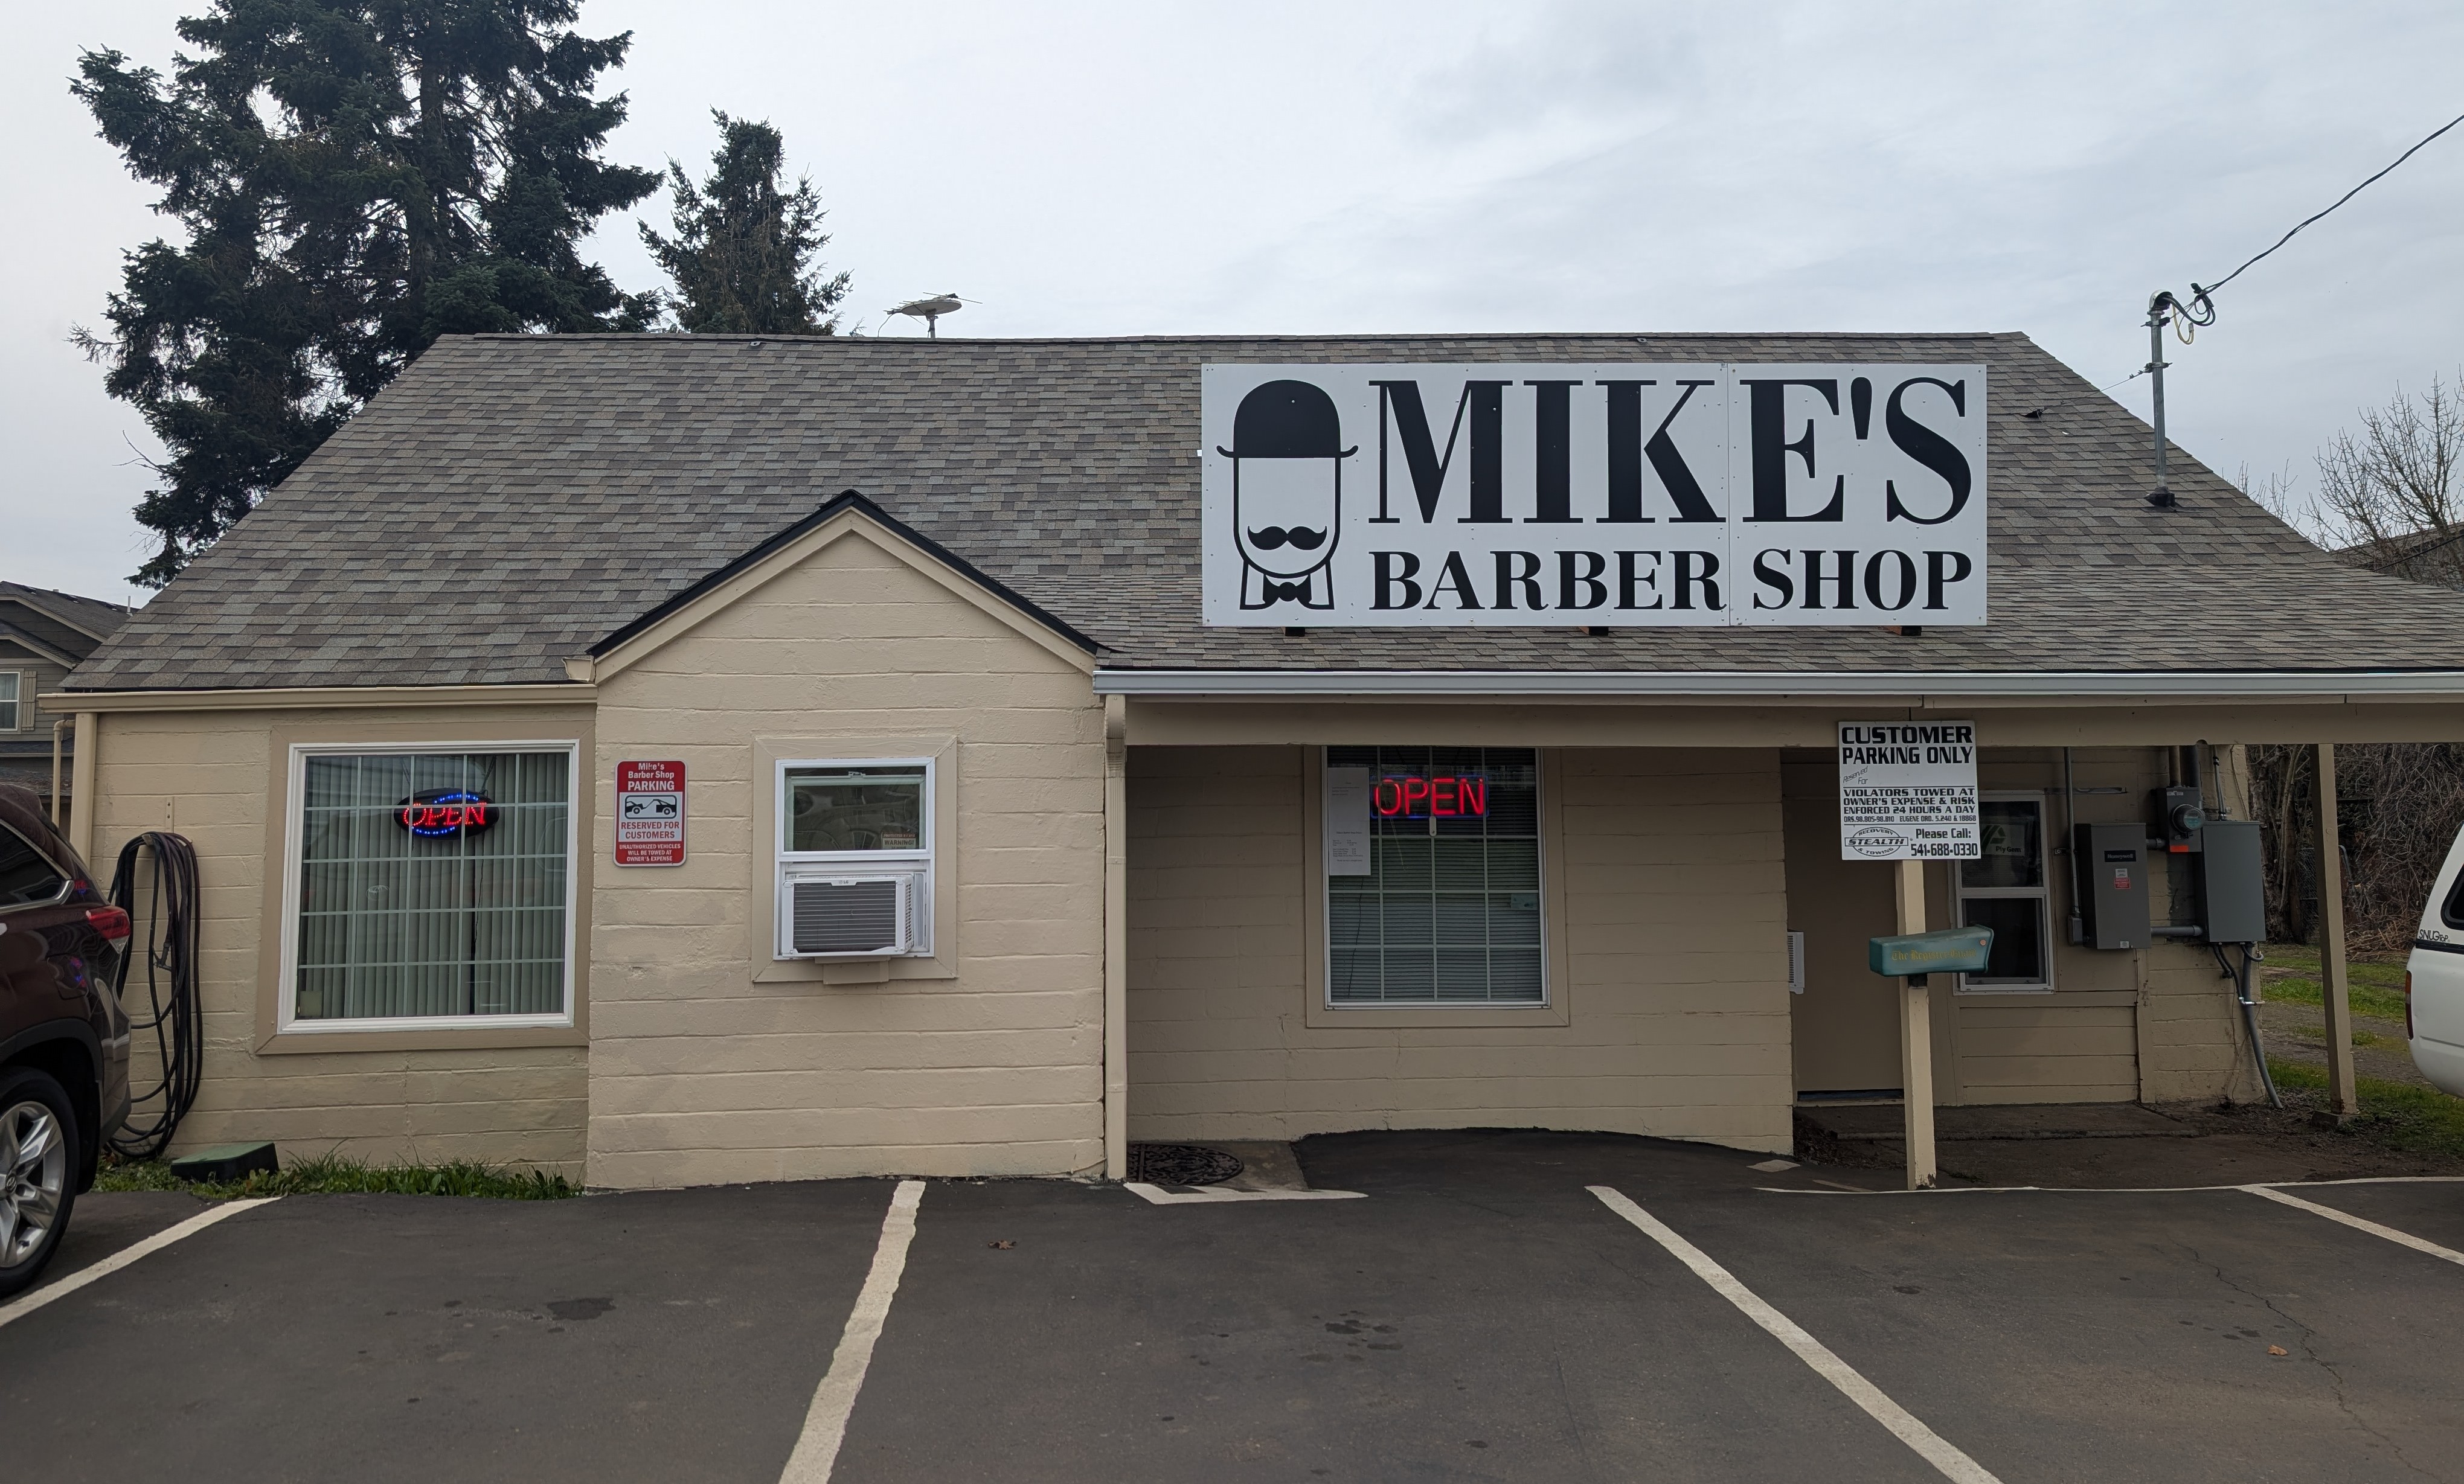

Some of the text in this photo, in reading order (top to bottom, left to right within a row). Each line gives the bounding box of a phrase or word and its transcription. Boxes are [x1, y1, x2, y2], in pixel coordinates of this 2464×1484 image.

[1368, 377, 1972, 525] MIKE'S
[1368, 548, 1972, 611] BARBER SHOP
[1841, 726, 1973, 744] CUSTOMER
[1842, 746, 1974, 764] PARKING ONLY
[655, 770, 675, 779] Shop
[1843, 766, 1869, 783] Reserved
[627, 781, 675, 791] PARKING
[1843, 788, 1909, 797] VIOLATORS
[1374, 778, 1484, 815] OPEN
[403, 802, 487, 826] OPEN
[625, 831, 675, 839] CUSTOMERS
[1916, 828, 1971, 839] Please Call:
[1911, 843, 1978, 856] 541-688-0330
